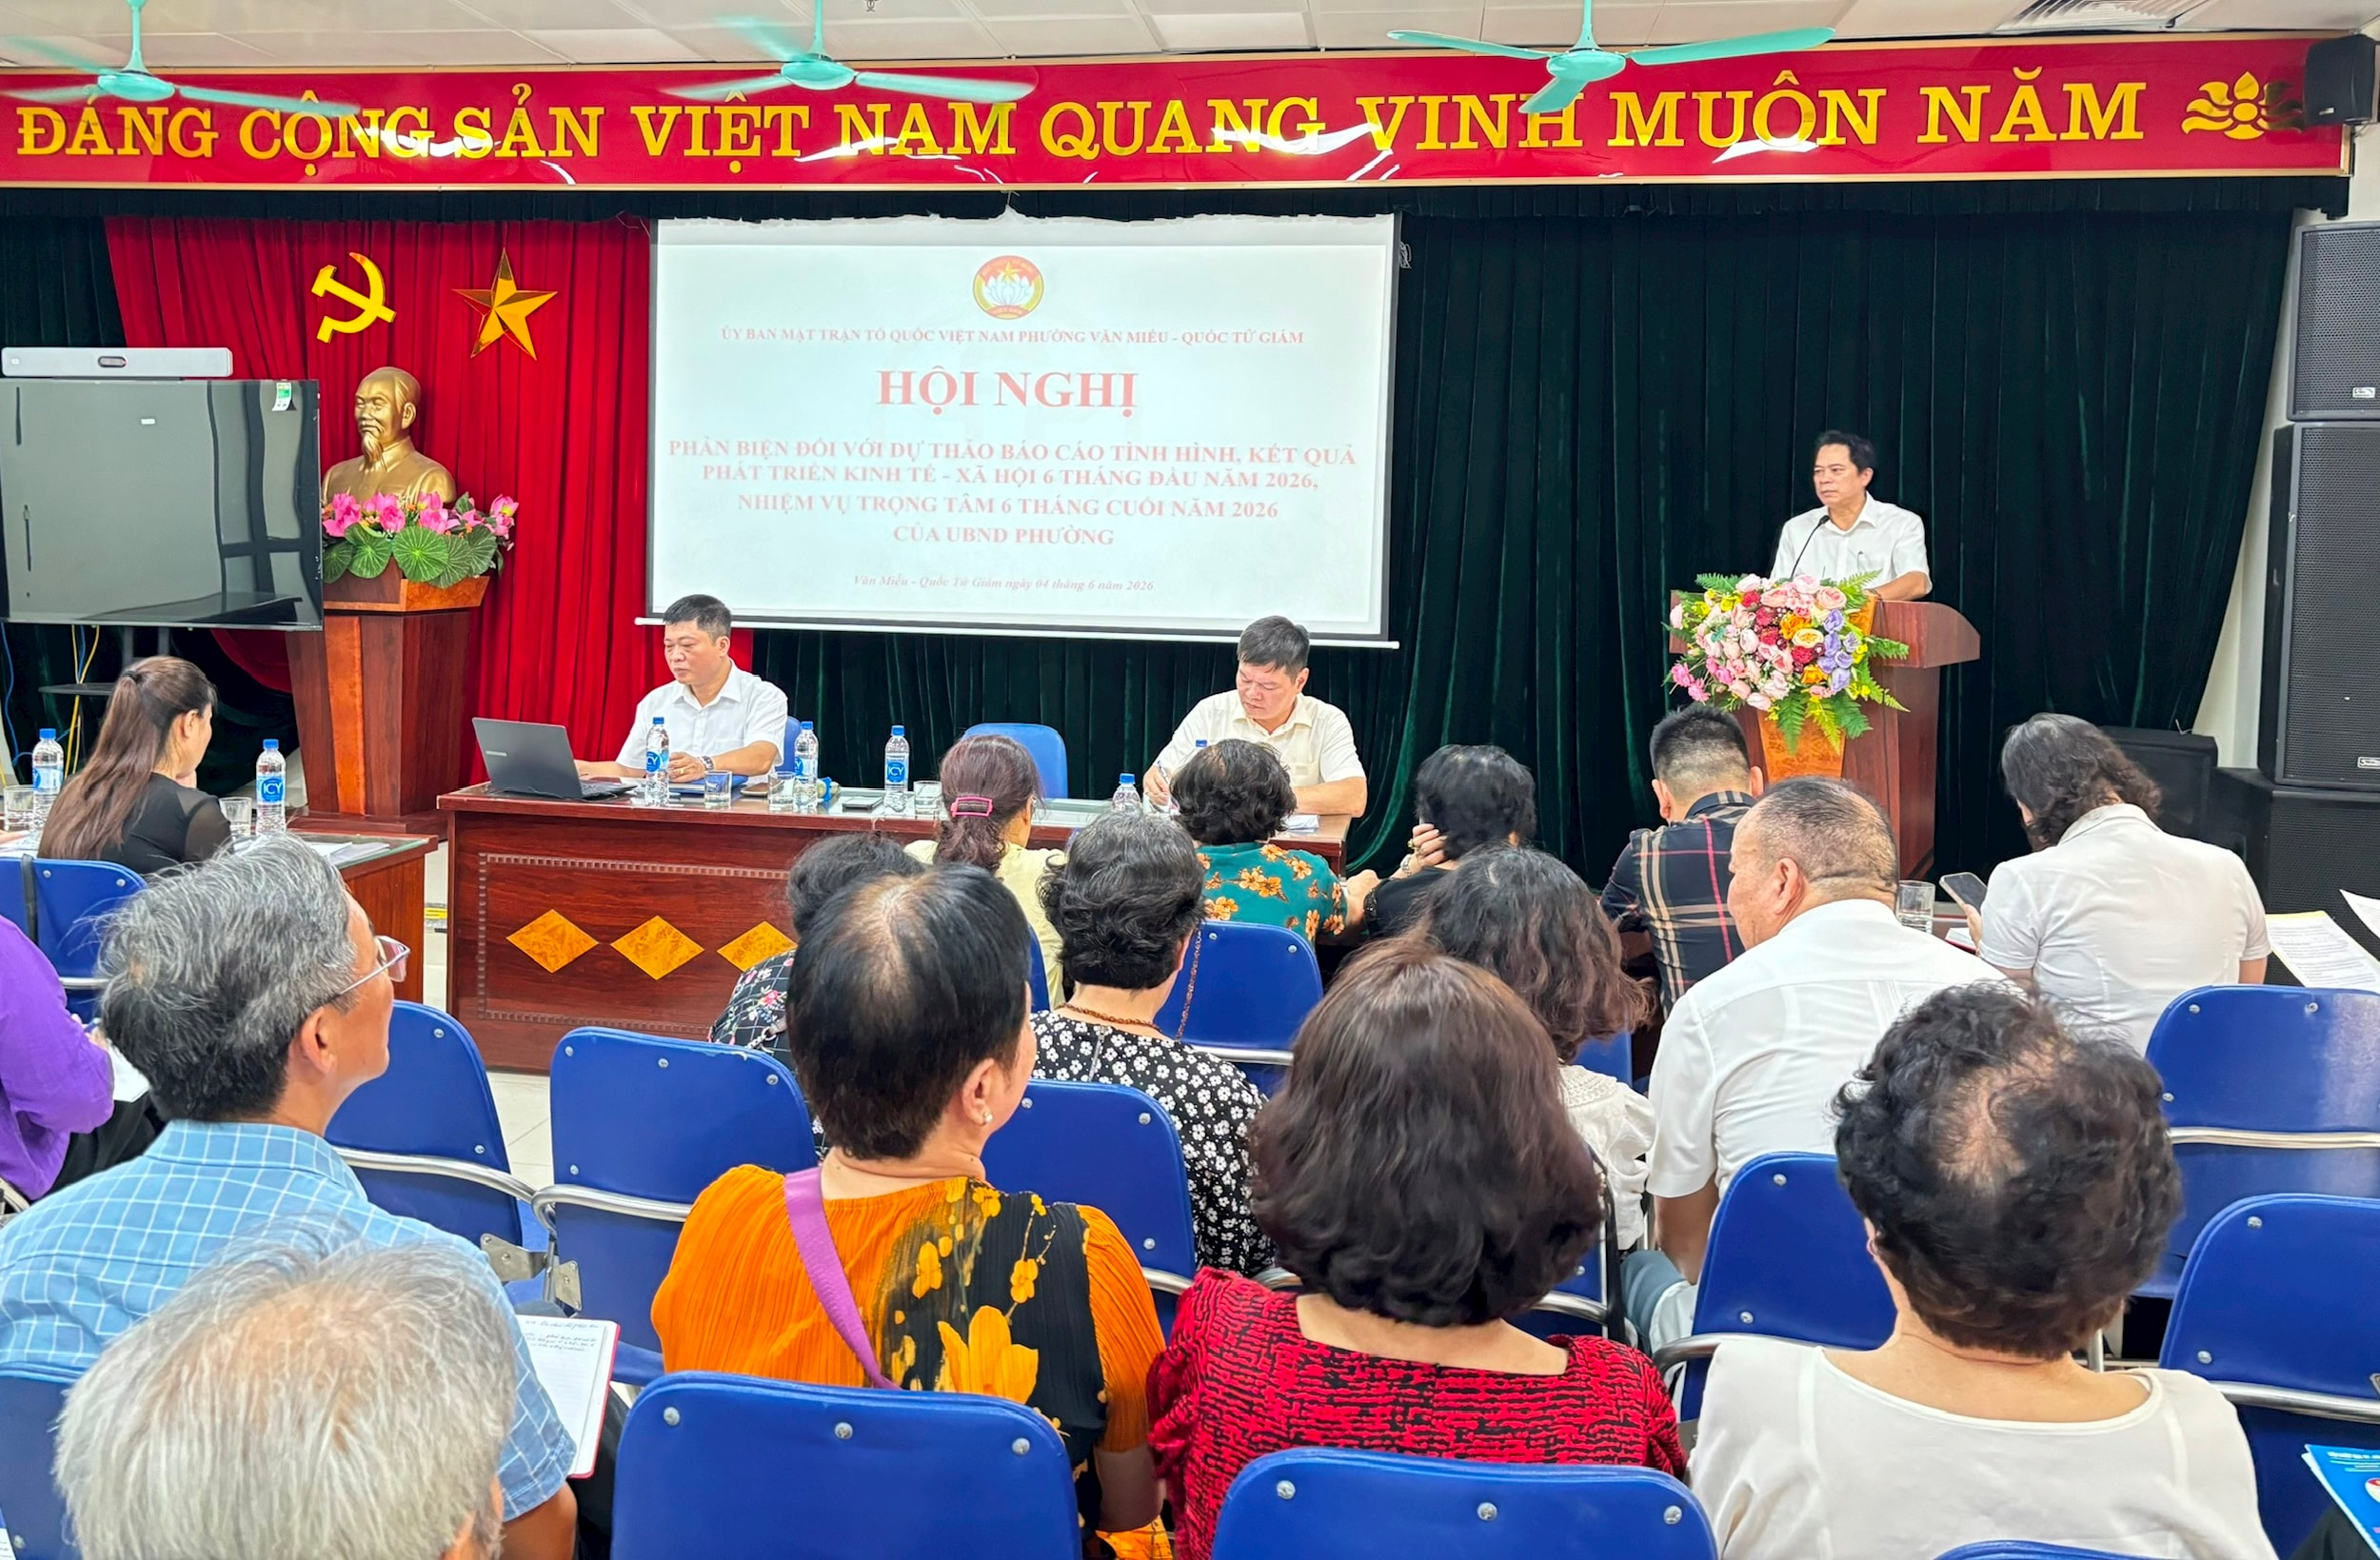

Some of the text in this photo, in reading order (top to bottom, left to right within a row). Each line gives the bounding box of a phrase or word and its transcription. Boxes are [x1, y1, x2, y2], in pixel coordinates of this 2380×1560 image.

[239, 89, 436, 177] CỘNG
[453, 83, 605, 159] SẢN
[630, 90, 809, 174] VIỆT
[834, 101, 1017, 157] NAM
[1040, 97, 1326, 161] QUANG
[1355, 92, 1583, 151] VINH
[1607, 69, 1887, 148] MUÔN
[1916, 66, 2147, 144] NĂM
[746, 328, 780, 341] BAN
[782, 327, 815, 343] MẶT
[819, 327, 861, 343] TRẬN
[864, 326, 886, 342] TỔ
[890, 327, 935, 344] QUỐC
[939, 328, 975, 344] VIỆT
[978, 330, 1014, 343] NAM
[1019, 327, 1086, 344] PHƯỜNG
[1089, 328, 1122, 344] VĂN
[1126, 328, 1168, 344] MIẾU
[1181, 329, 1228, 346] QUỐC
[1259, 328, 1303, 344] GIÁM
[876, 365, 1139, 418] HỘI NGHỊ
[668, 436, 1357, 467] PHẢN BIỆN ĐỐI VỚI DỰ THẢO BÁO CÁO TÌNH HÌNH, KẾT QUẢ
[703, 461, 764, 481] PHÁT
[767, 461, 838, 482] TRIỂN
[843, 465, 902, 483] KINH
[907, 464, 937, 483] TẾ
[955, 464, 987, 484] XÃ
[994, 466, 1037, 488] HỘI
[1042, 468, 1054, 484] 6
[1060, 465, 1142, 486] THÁNG
[1148, 466, 1198, 487] ĐẦU
[1204, 467, 1258, 488] NĂM
[1264, 472, 1319, 491] 2026,
[738, 492, 1279, 519] NHIỆM VỤ TRỌNG TÂM 6 THÁNG CUỐI NĂM 2026
[893, 521, 1115, 545] CỦA UBND PHƯỜNG
[1036, 579, 1049, 589] 04
[1052, 579, 1085, 592] tháng
[1087, 580, 1096, 590] 6
[1126, 580, 1155, 591] 2026
[887, 766, 904, 776] ICY
[263, 782, 283, 795] ICY
